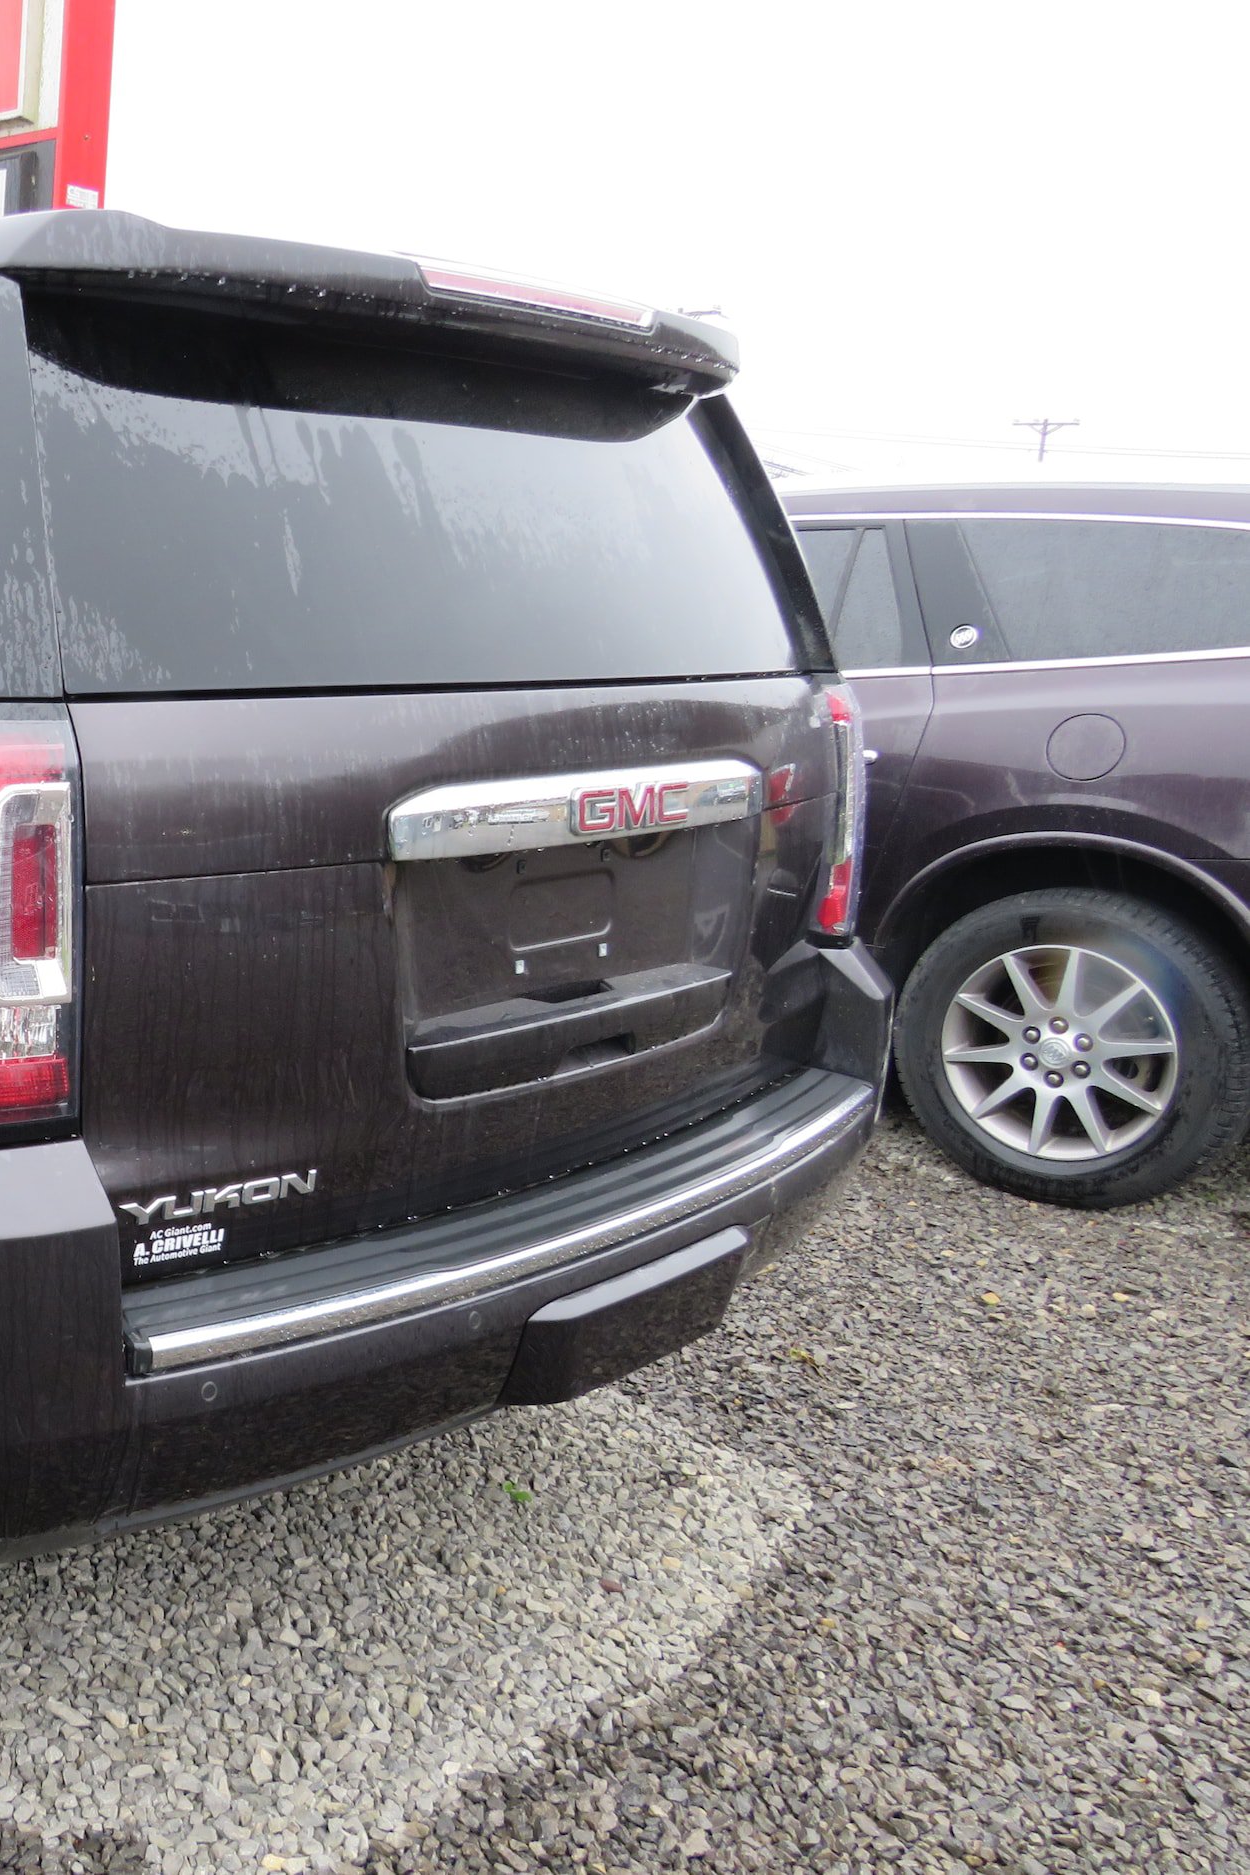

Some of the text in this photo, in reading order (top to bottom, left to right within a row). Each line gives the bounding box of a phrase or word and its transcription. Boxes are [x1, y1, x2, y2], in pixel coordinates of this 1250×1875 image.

[575, 781, 690, 833] GMC
[119, 1169, 317, 1226] YUKON
[133, 1228, 225, 1258] A. CRIVELLI
[149, 1222, 212, 1240] AC Giant.com
[133, 1243, 222, 1266] The Automotive Giant
